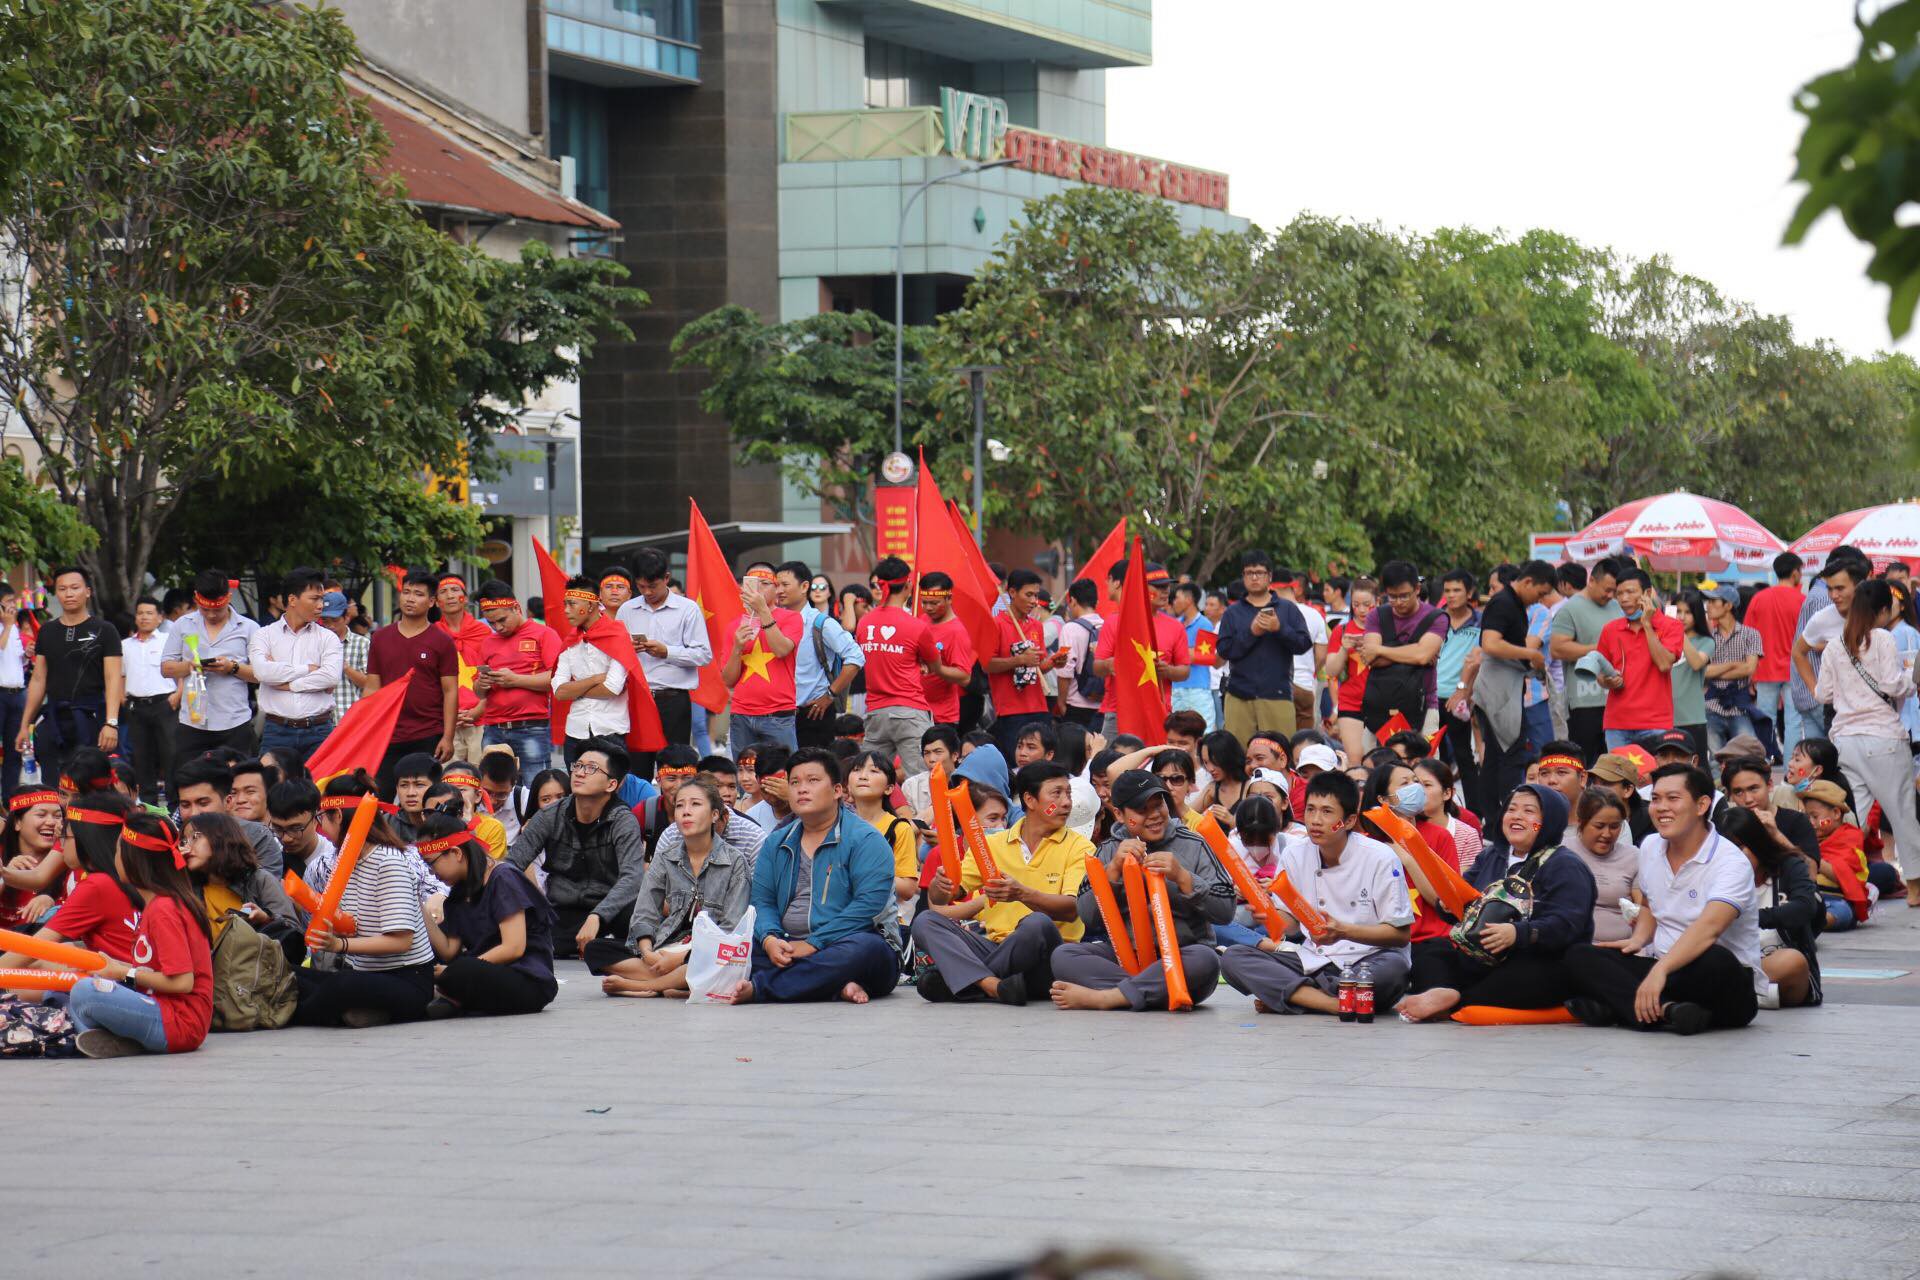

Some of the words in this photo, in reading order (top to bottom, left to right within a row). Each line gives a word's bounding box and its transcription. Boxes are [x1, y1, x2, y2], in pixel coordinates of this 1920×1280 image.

[939, 86, 1009, 161] VTP
[1004, 128, 1080, 179] OFFICE
[1079, 143, 1161, 195] SERVICE
[1159, 161, 1228, 210] CENTER
[860, 640, 879, 653] VIỆT
[880, 643, 904, 654] NAM
[867, 625, 875, 641] I
[1152, 892, 1170, 957] vietnamobile
